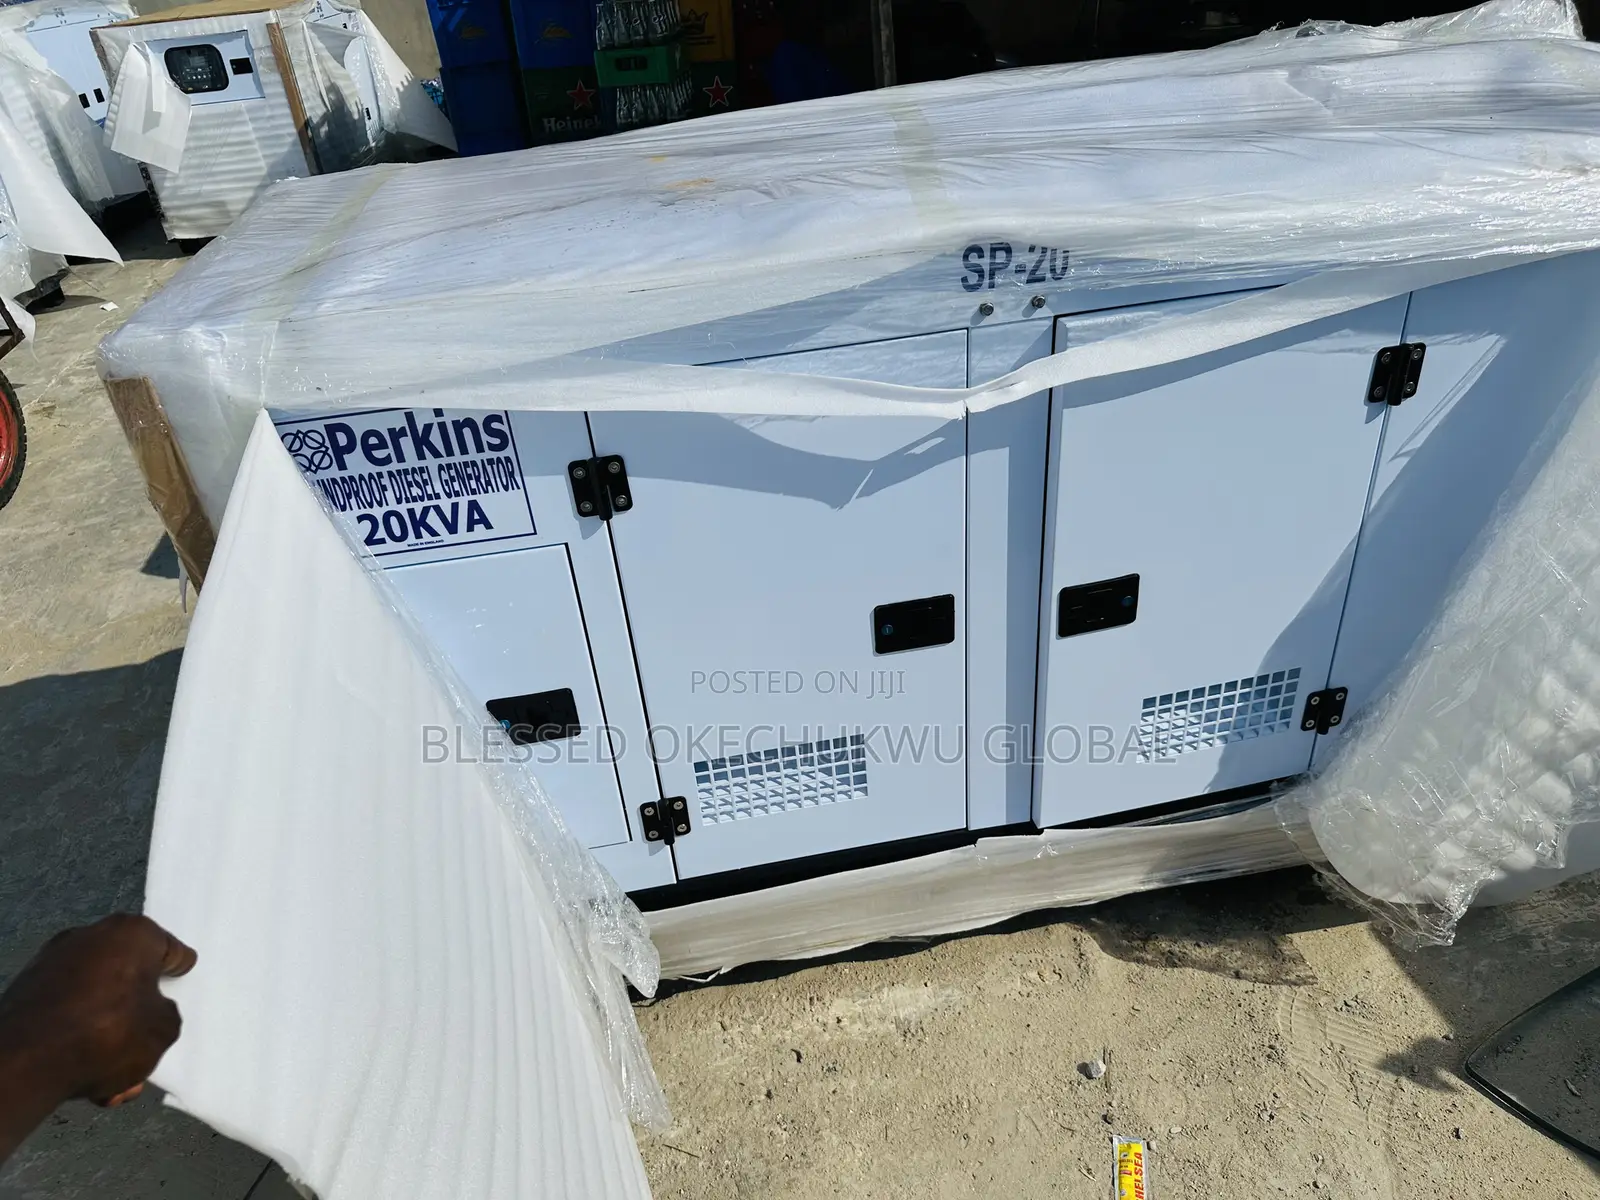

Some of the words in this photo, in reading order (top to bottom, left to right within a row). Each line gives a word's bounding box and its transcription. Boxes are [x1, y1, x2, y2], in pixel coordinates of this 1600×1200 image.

[541, 114, 601, 134] Heinek
[961, 242, 1069, 292] SP-20
[324, 408, 509, 471] Perkins
[316, 471, 389, 513] NDPROOF
[387, 466, 441, 506] DIESEL
[437, 455, 521, 499] GENERATOR
[356, 499, 494, 547] 20KVA
[1134, 1152, 1145, 1200] HELSEA
